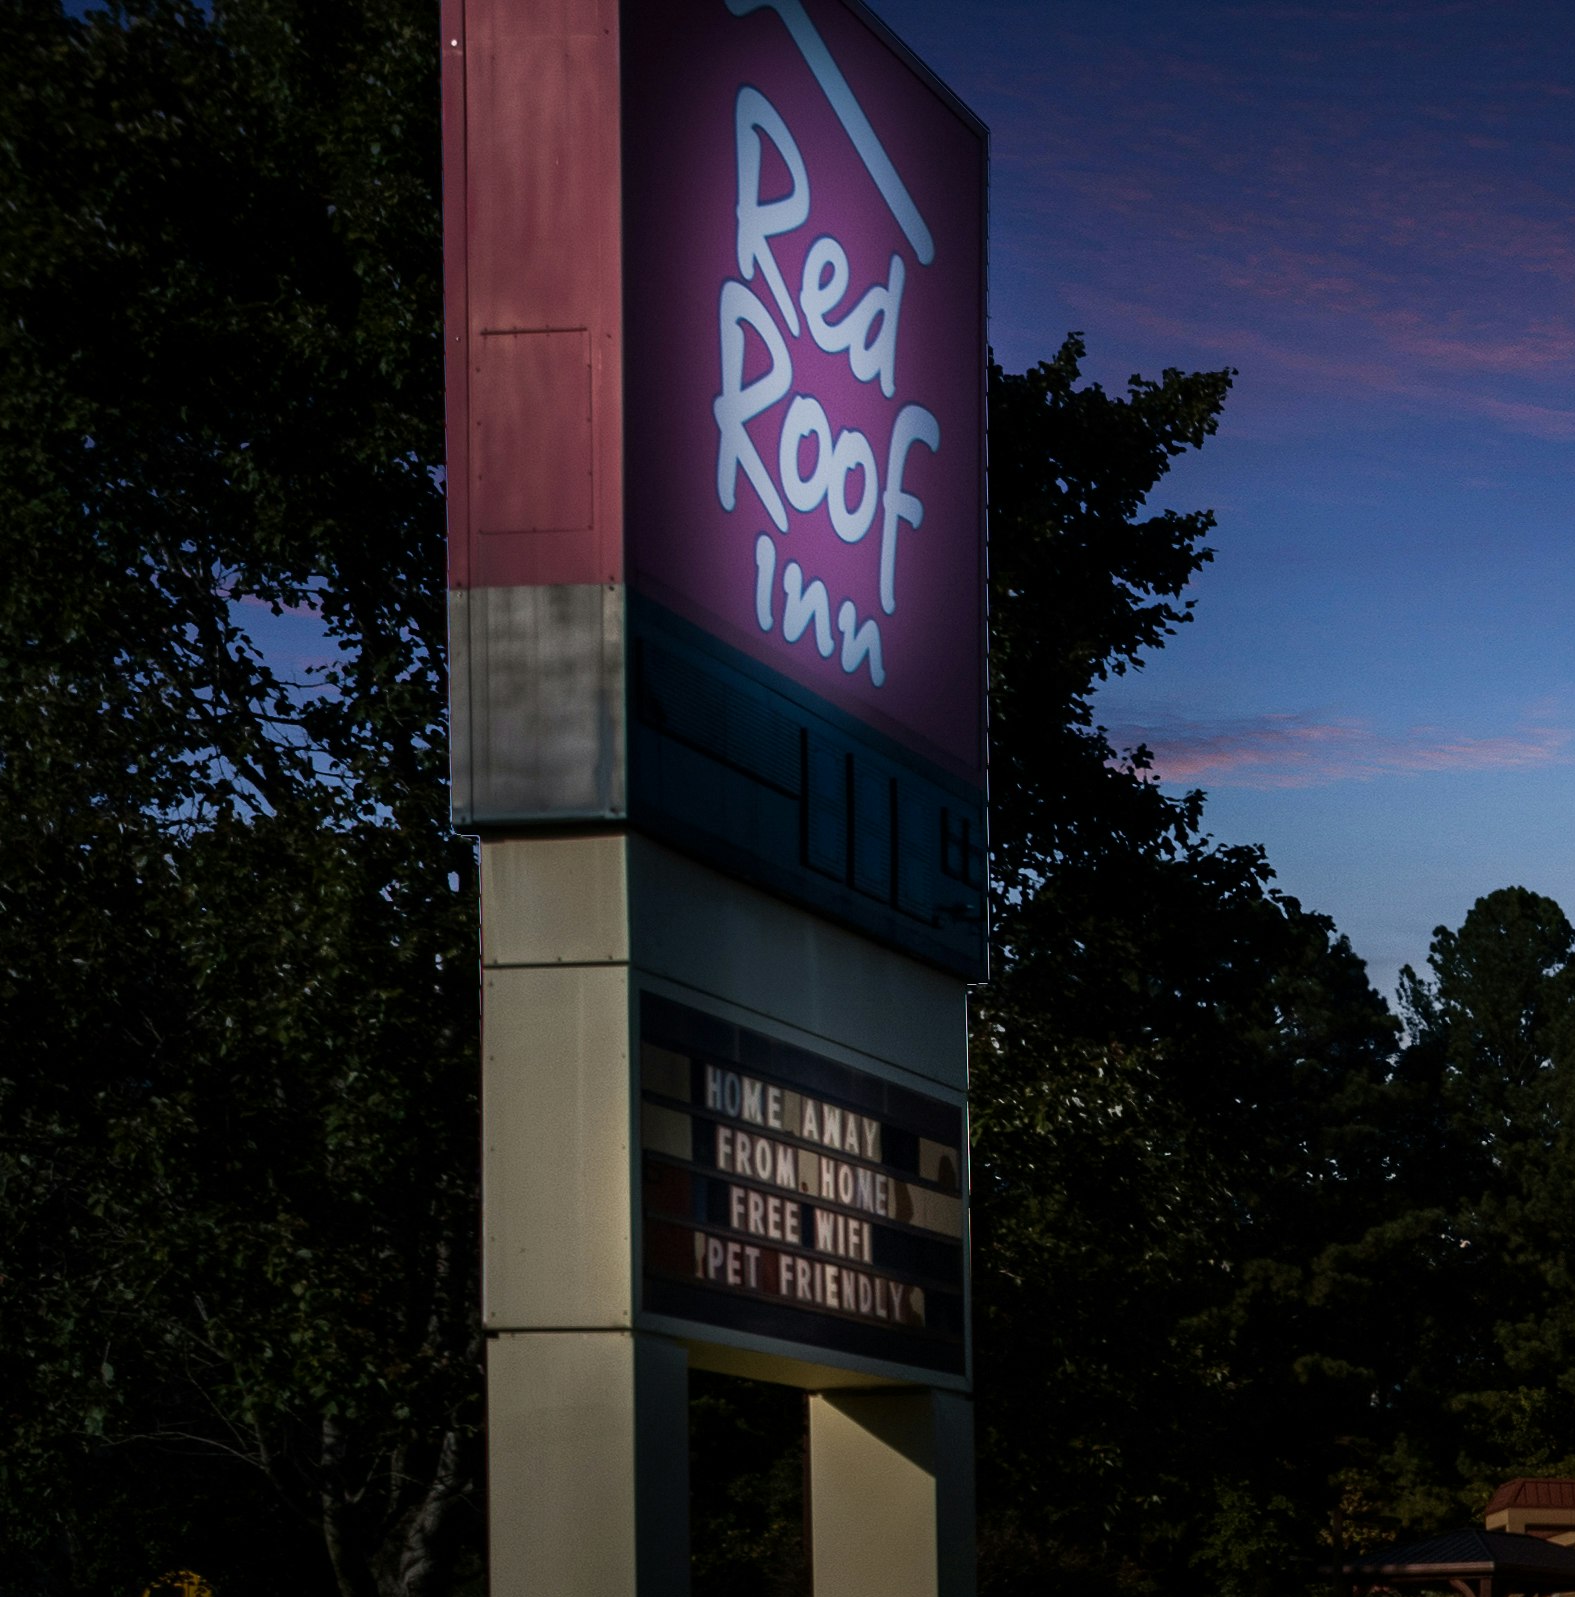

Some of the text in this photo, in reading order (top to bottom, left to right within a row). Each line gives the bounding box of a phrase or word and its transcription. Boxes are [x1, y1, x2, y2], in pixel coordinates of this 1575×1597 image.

[735, 86, 906, 399] Red
[713, 279, 941, 615] Roof
[755, 534, 886, 688] Inn
[704, 1062, 878, 1158] HOME AWAY
[716, 1124, 888, 1217] FROM HOME
[729, 1184, 874, 1265] FREE WIFI
[706, 1235, 905, 1320] PET FRIENDLY
